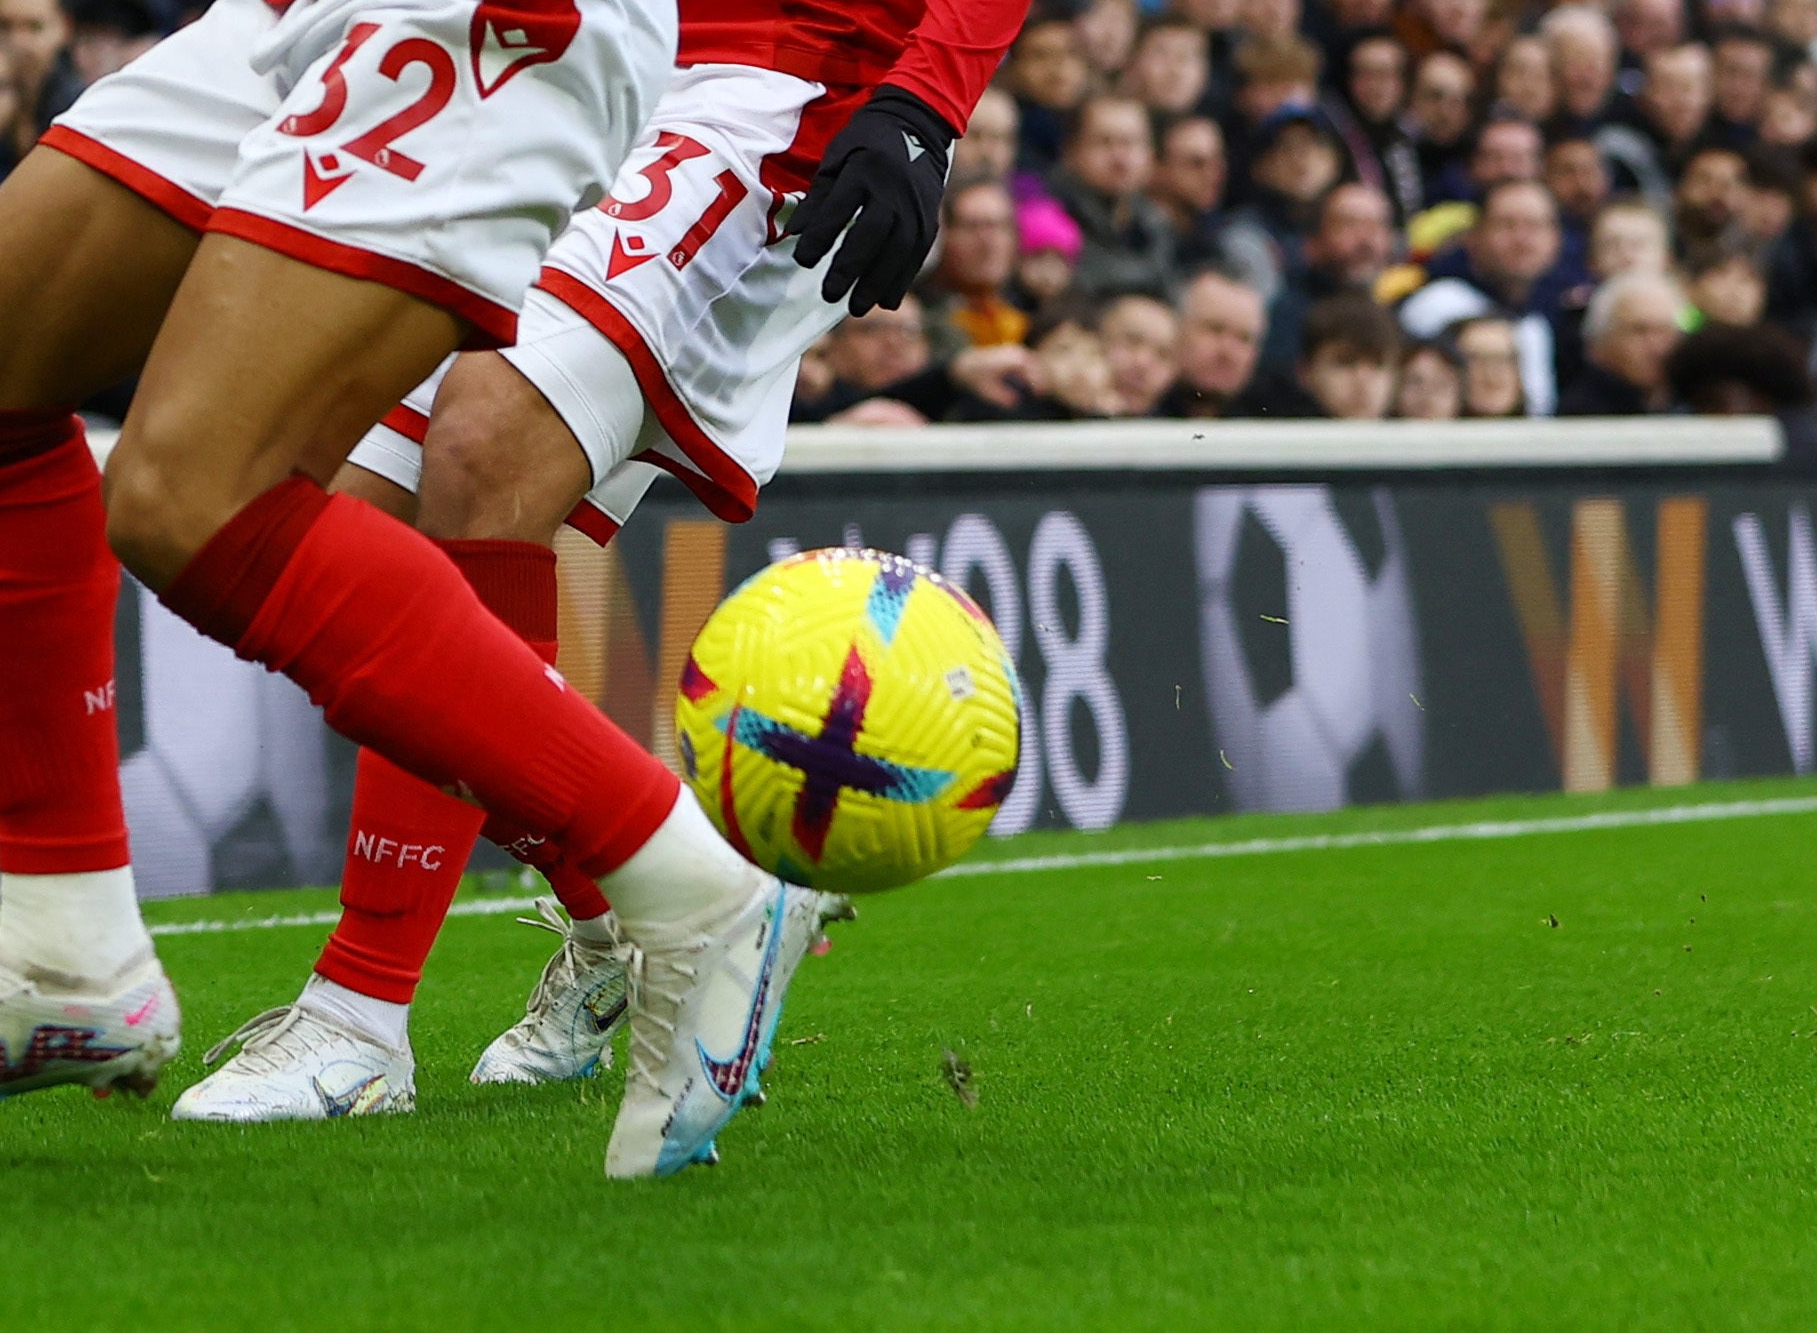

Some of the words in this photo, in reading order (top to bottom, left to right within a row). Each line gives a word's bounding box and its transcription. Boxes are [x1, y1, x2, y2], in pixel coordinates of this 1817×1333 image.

[276, 22, 456, 182] 32
[596, 131, 750, 271] 31
[353, 829, 446, 871] NFFC
